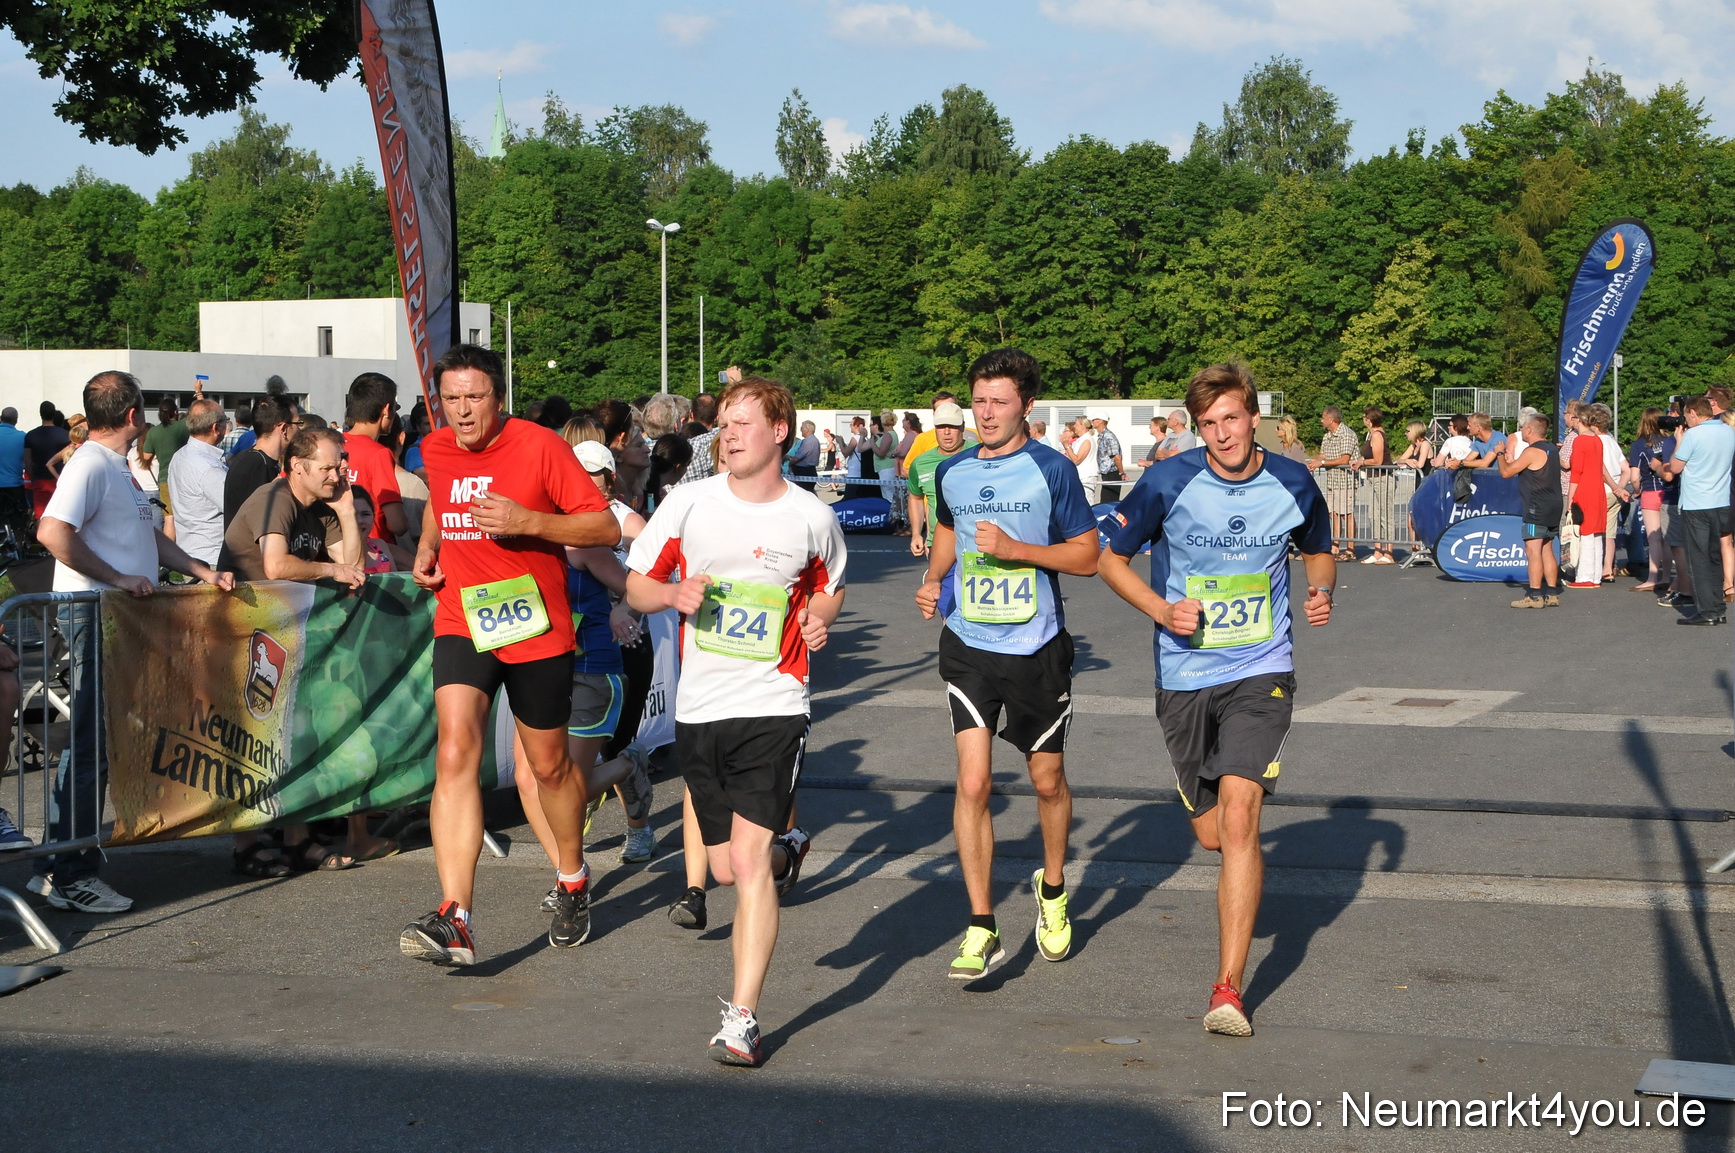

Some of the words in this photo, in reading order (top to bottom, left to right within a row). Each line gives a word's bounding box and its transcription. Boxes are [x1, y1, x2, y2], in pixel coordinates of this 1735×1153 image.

[1607, 291, 1624, 317] Druck
[1630, 242, 1646, 275] Medien
[1564, 272, 1626, 376] Frischmann
[450, 476, 493, 508] MRT
[839, 513, 886, 527] ischer
[950, 502, 1031, 516] SCHABMÜLLER
[1449, 503, 1506, 523] Fisch
[441, 529, 482, 541] Running
[1186, 534, 1283, 548] SCHABMÜLLER
[1222, 552, 1247, 561] TEAM
[965, 576, 1033, 605] 1214
[477, 598, 533, 632] 846
[710, 604, 768, 641] 124
